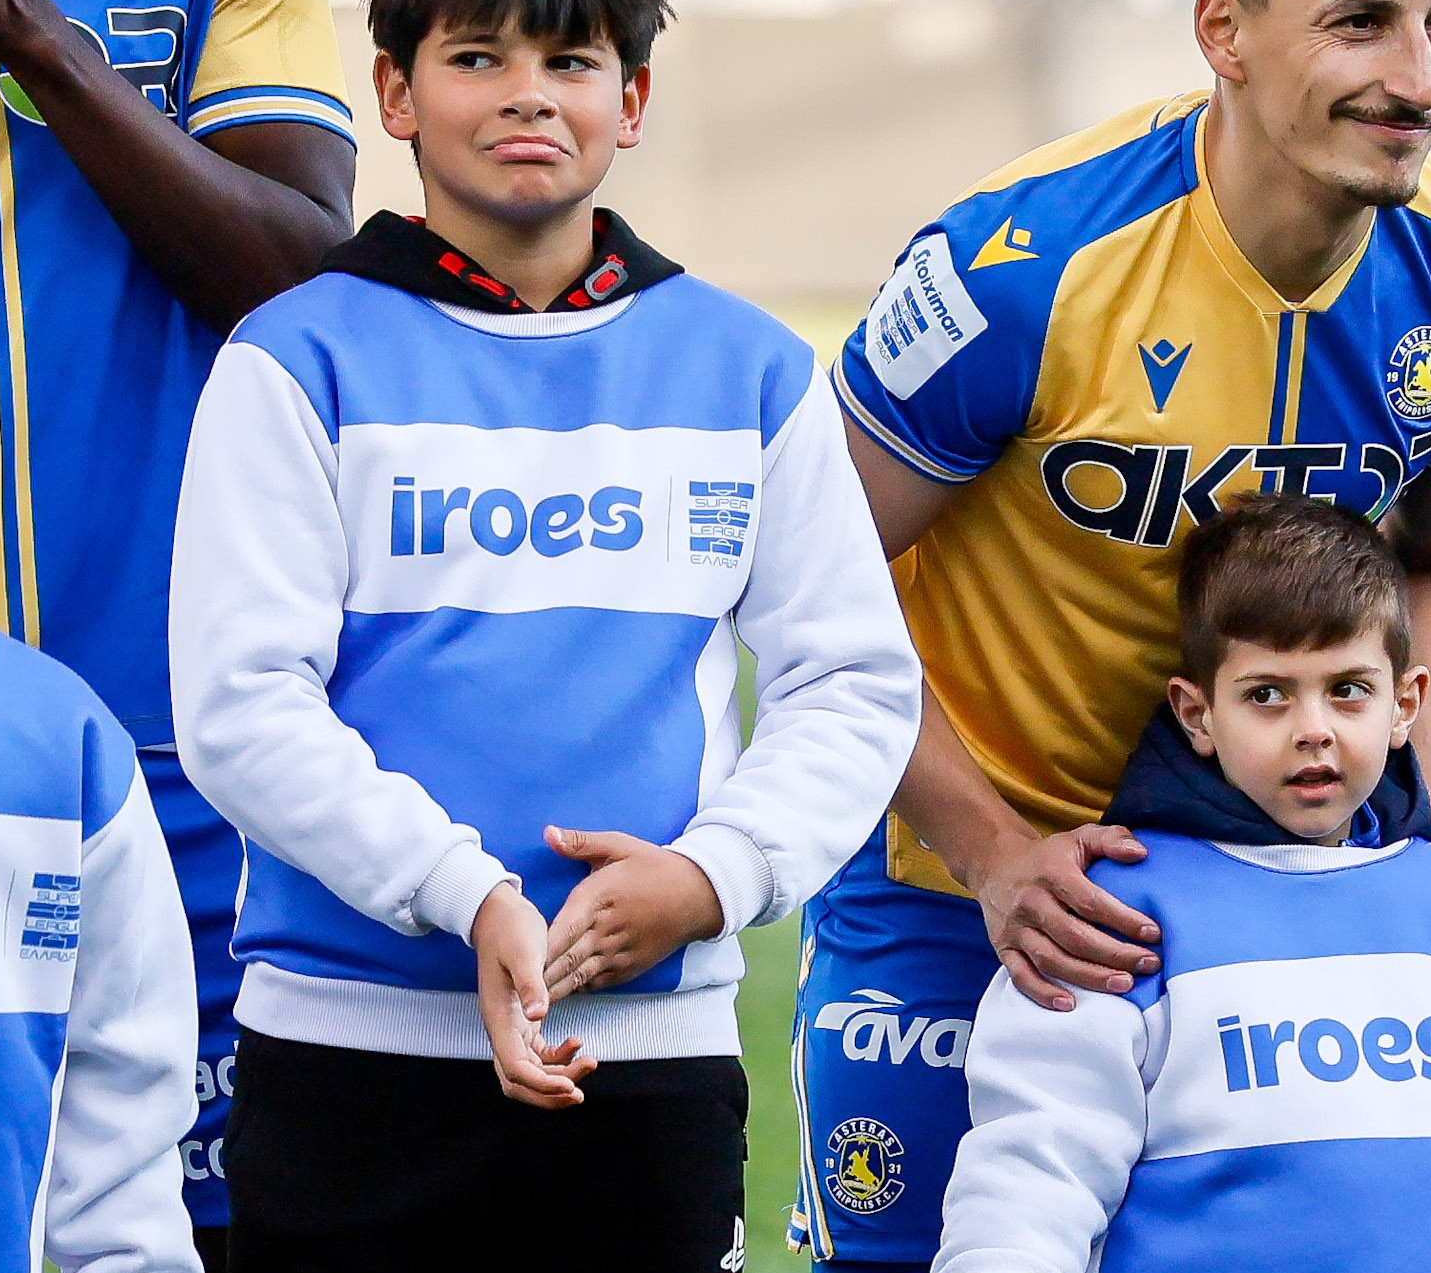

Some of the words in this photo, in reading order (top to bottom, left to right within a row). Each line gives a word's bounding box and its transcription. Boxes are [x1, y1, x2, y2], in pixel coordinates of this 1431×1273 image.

[913, 249, 964, 342] Stoiximan
[1386, 371, 1399, 382] 19
[1395, 397, 1431, 416] TRIPOLIS
[695, 498, 748, 511] SUPER
[390, 476, 643, 558] iroes
[690, 525, 746, 540] LEAGUE
[843, 1011, 972, 1069] ava
[833, 1121, 895, 1147] ASTERAS
[825, 1158, 835, 1169] 19
[888, 1163, 901, 1174] 31
[832, 1184, 874, 1209] TRIPOLIS
